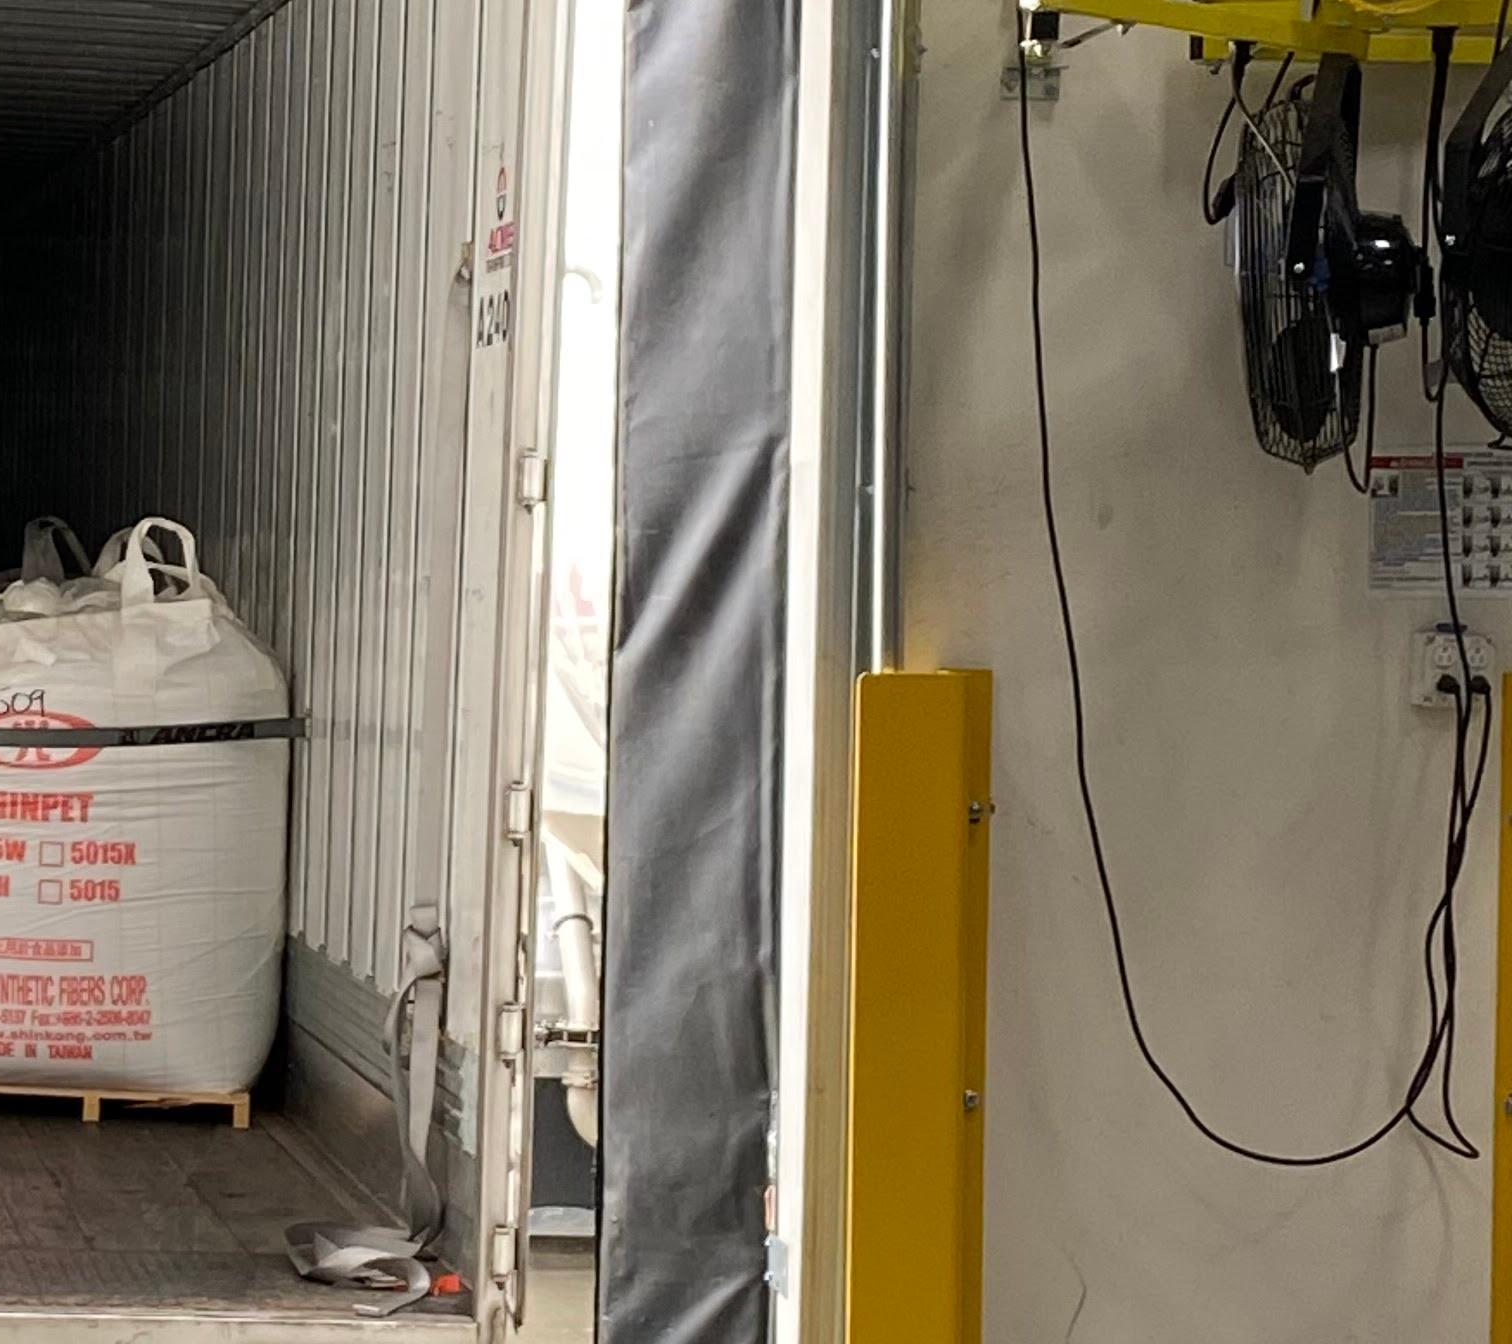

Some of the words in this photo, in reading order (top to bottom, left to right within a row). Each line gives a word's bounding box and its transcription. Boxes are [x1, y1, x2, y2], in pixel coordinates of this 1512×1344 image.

[70, 879, 120, 902] 5015
[59, 974, 105, 1006] FIBERS
[110, 974, 151, 1006] CORP.
[25, 1043, 37, 1058] IN
[48, 1044, 93, 1060] TAIWAN
